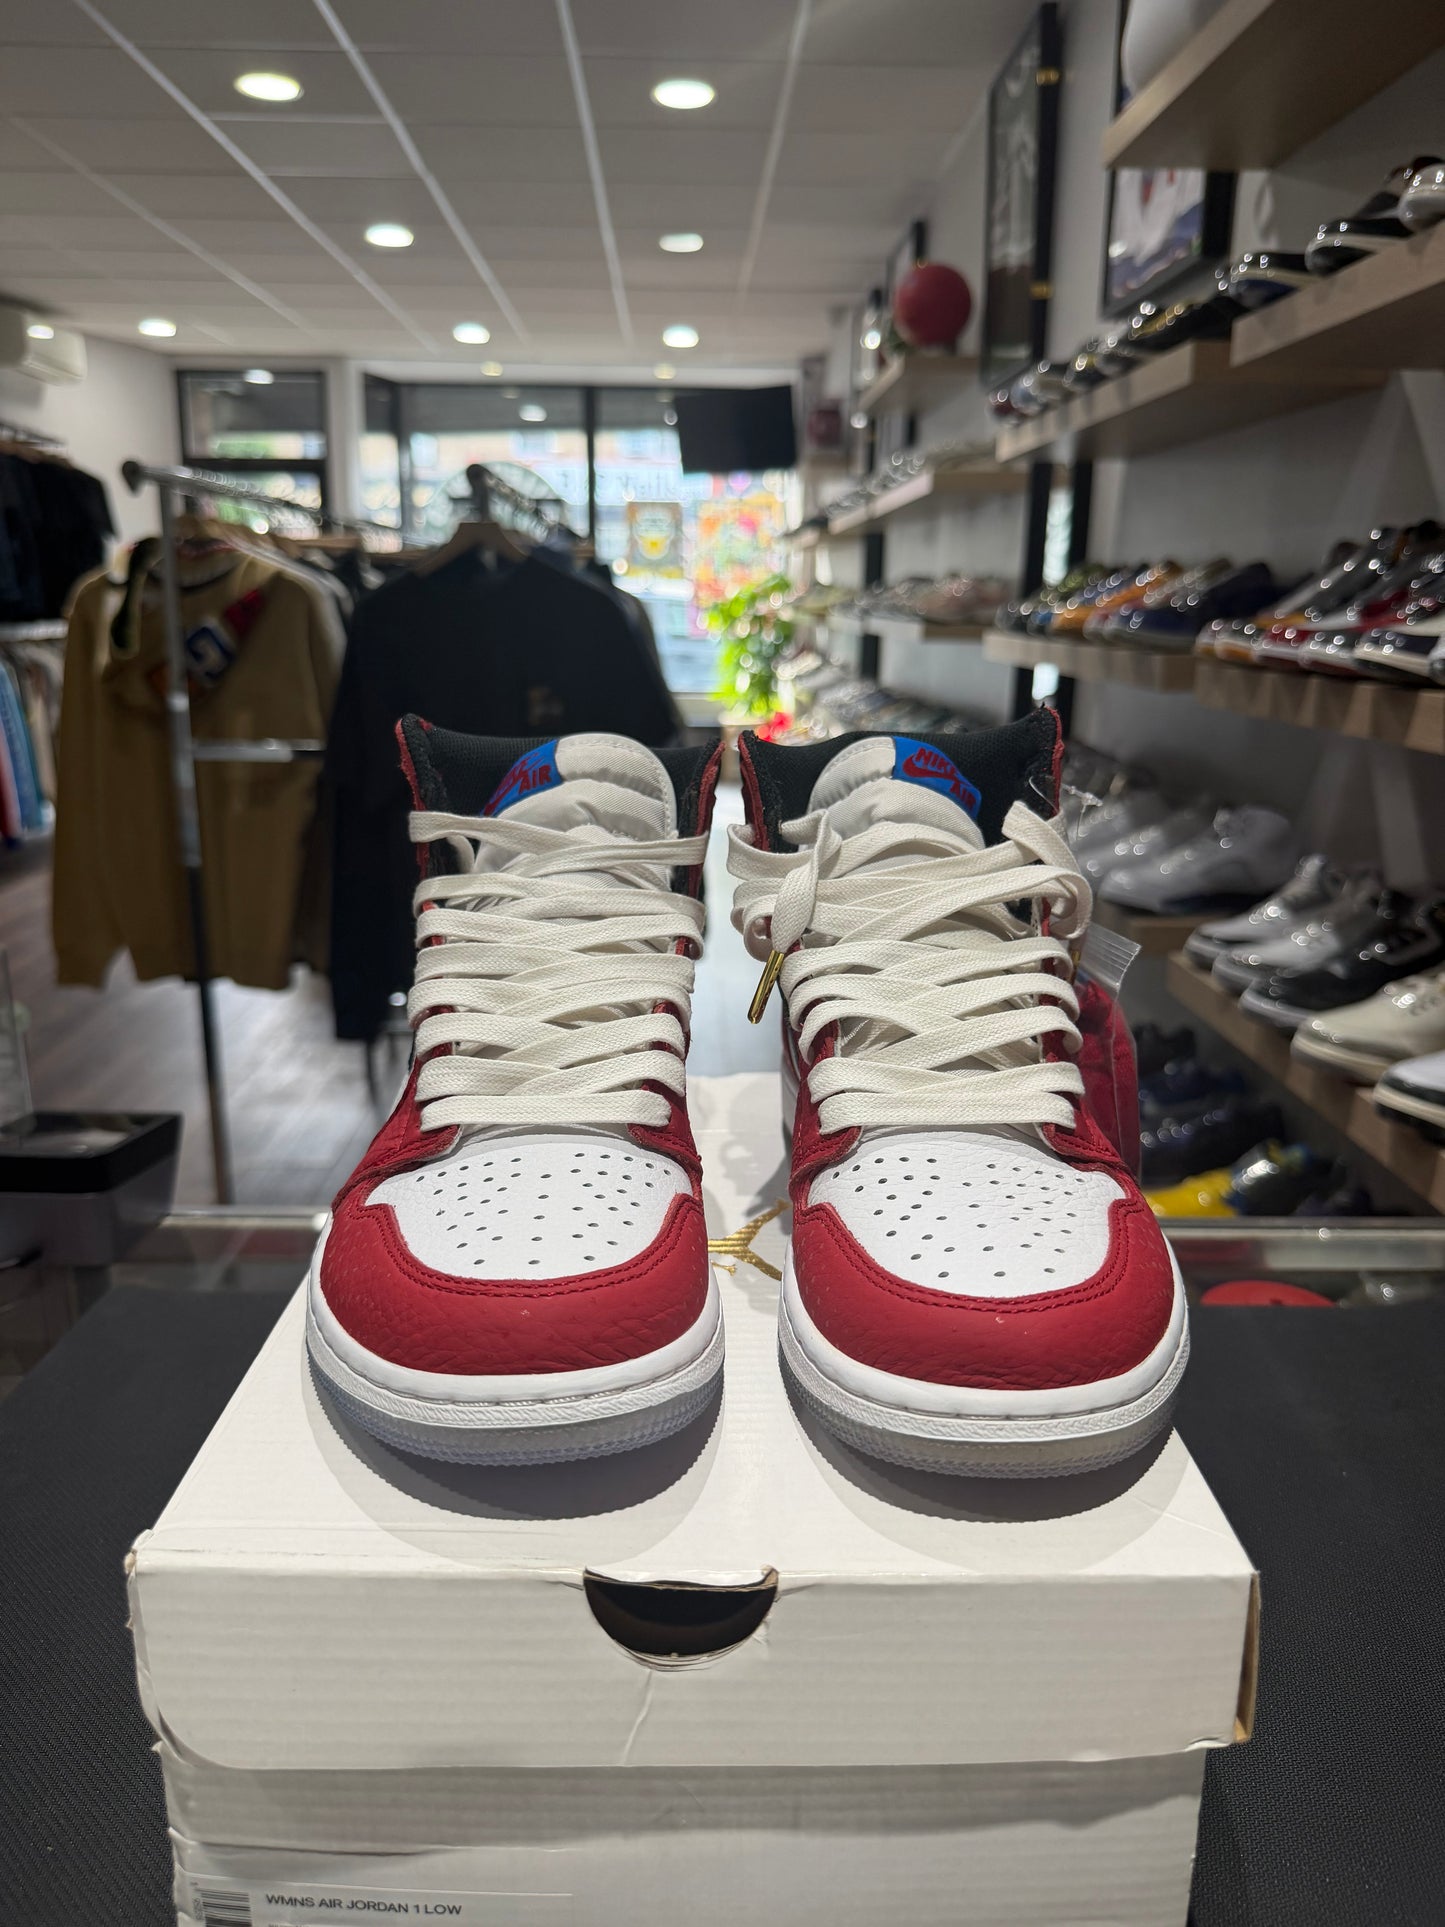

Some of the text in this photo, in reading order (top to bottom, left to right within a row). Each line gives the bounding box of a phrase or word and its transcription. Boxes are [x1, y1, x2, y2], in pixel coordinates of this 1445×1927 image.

[518, 764, 552, 795] AIR
[265, 1893, 462, 1915] WMNS AIR JORDAN 1 LOW
